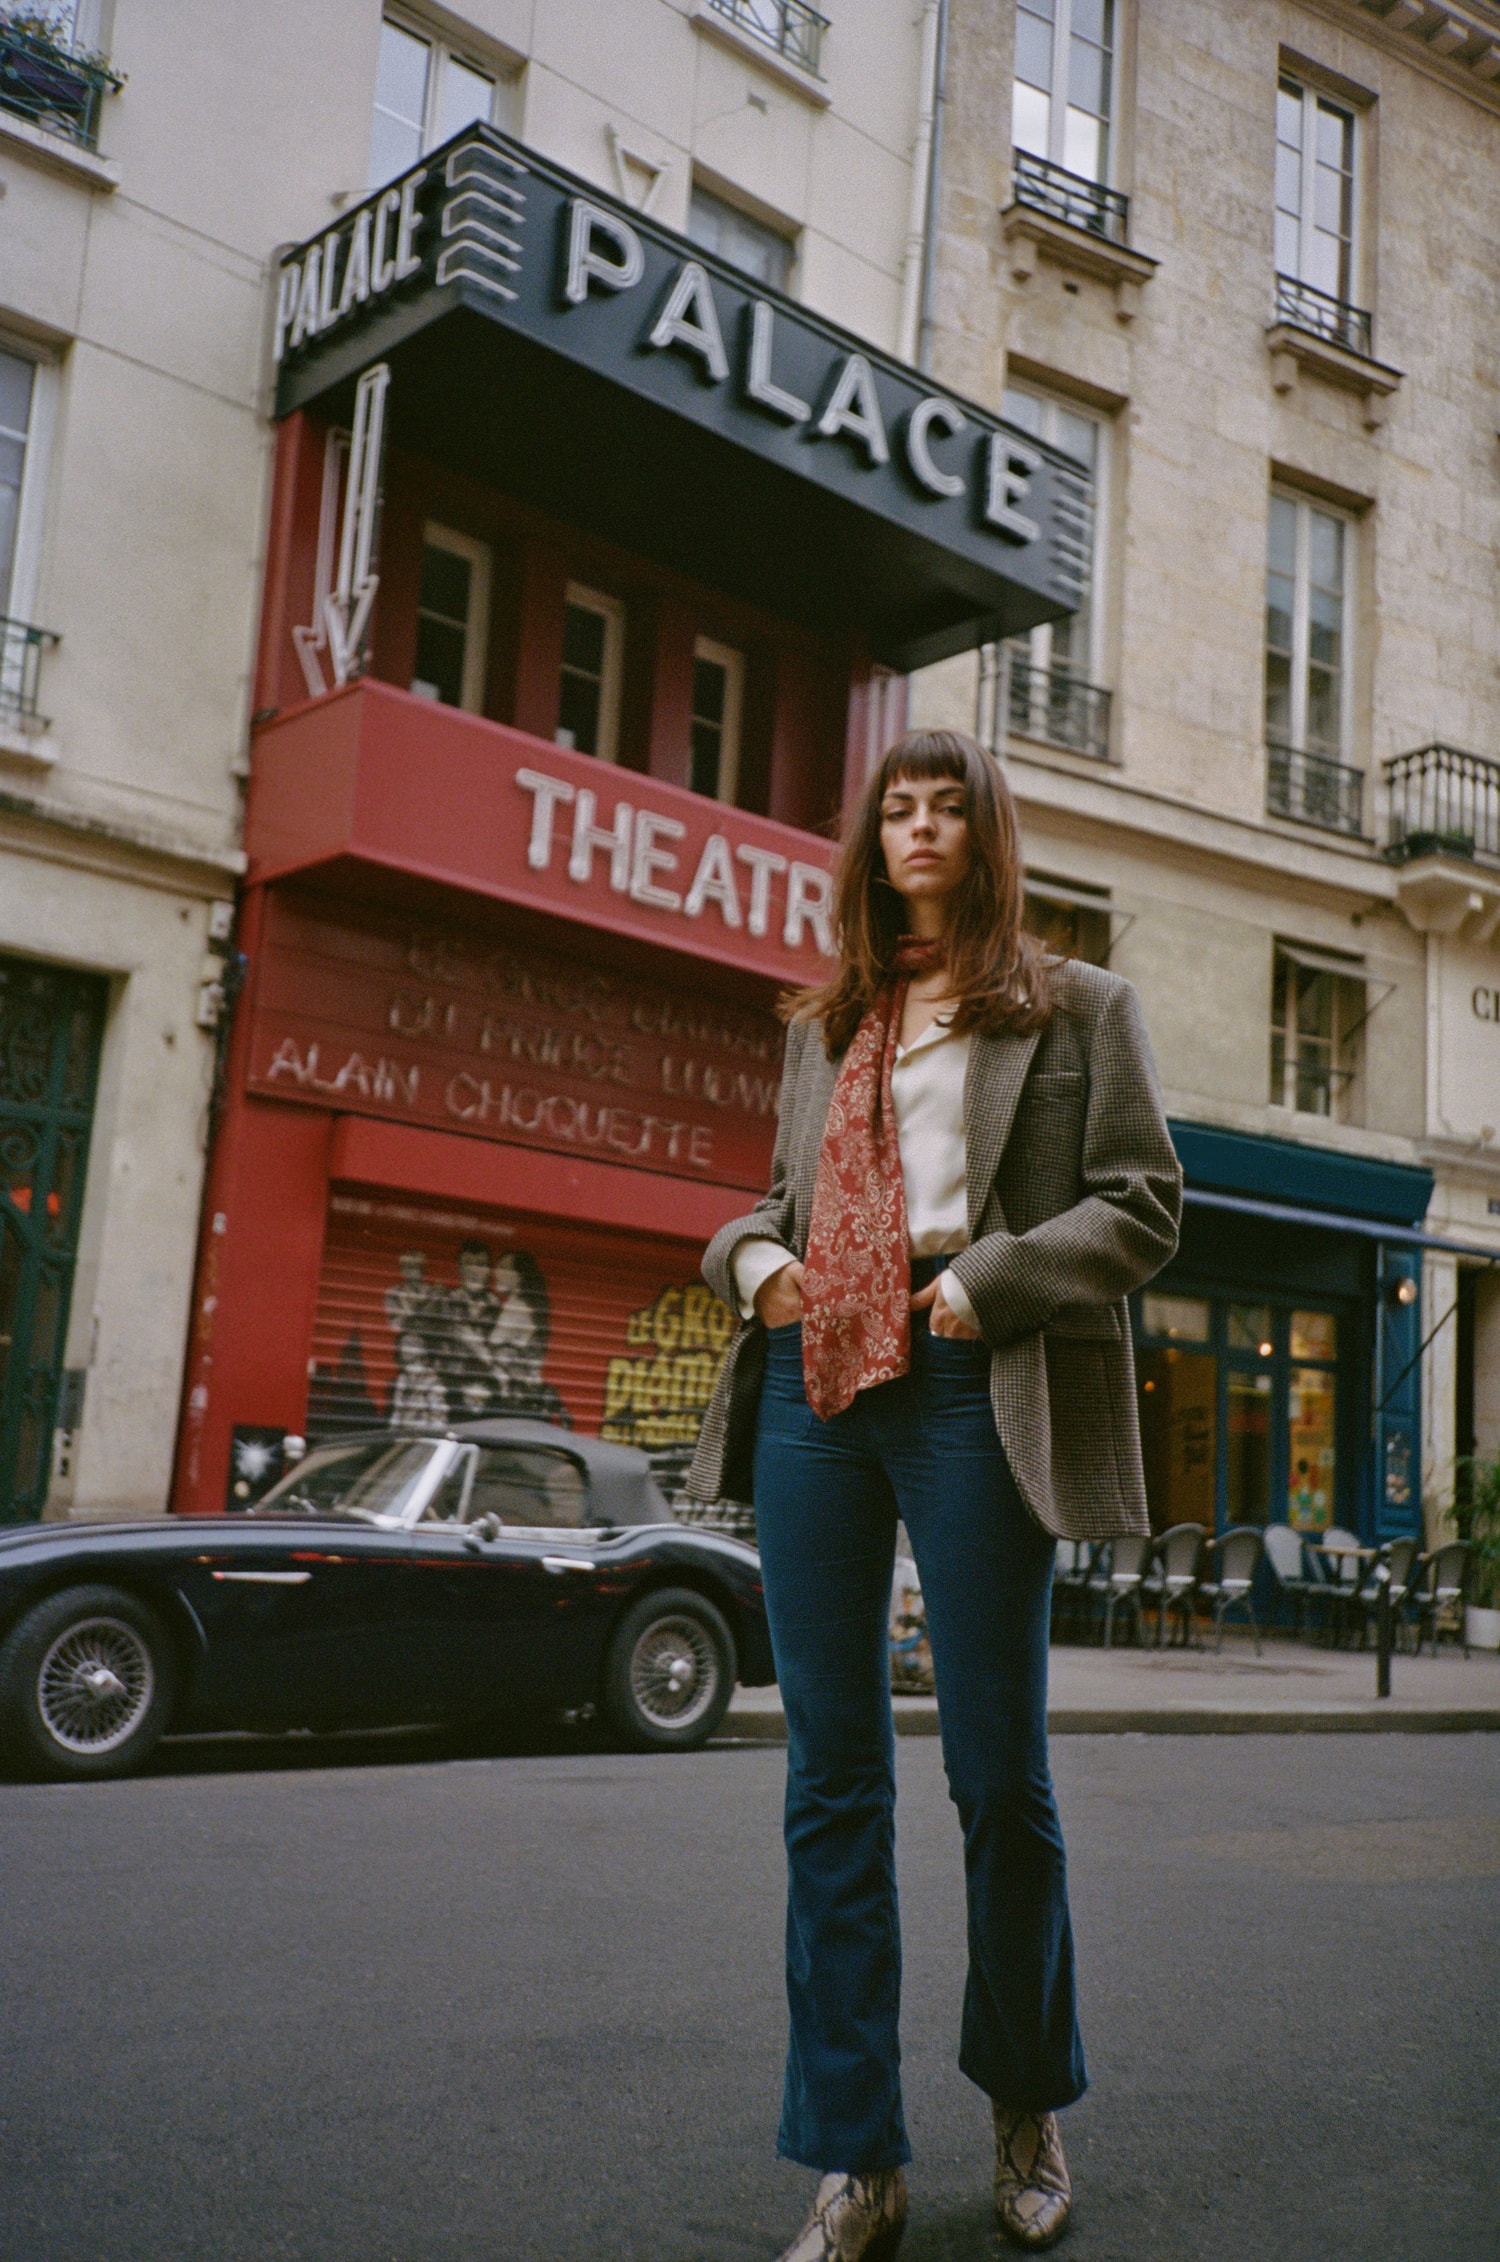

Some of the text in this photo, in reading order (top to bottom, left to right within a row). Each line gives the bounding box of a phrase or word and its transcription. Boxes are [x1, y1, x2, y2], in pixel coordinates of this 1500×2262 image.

[272, 167, 428, 362] PALACE
[565, 198, 1046, 544] PALACE
[514, 766, 840, 959] THEATR
[266, 1037, 713, 1168] ALAIN CHOQUETTE
[653, 1283, 733, 1352] GRO
